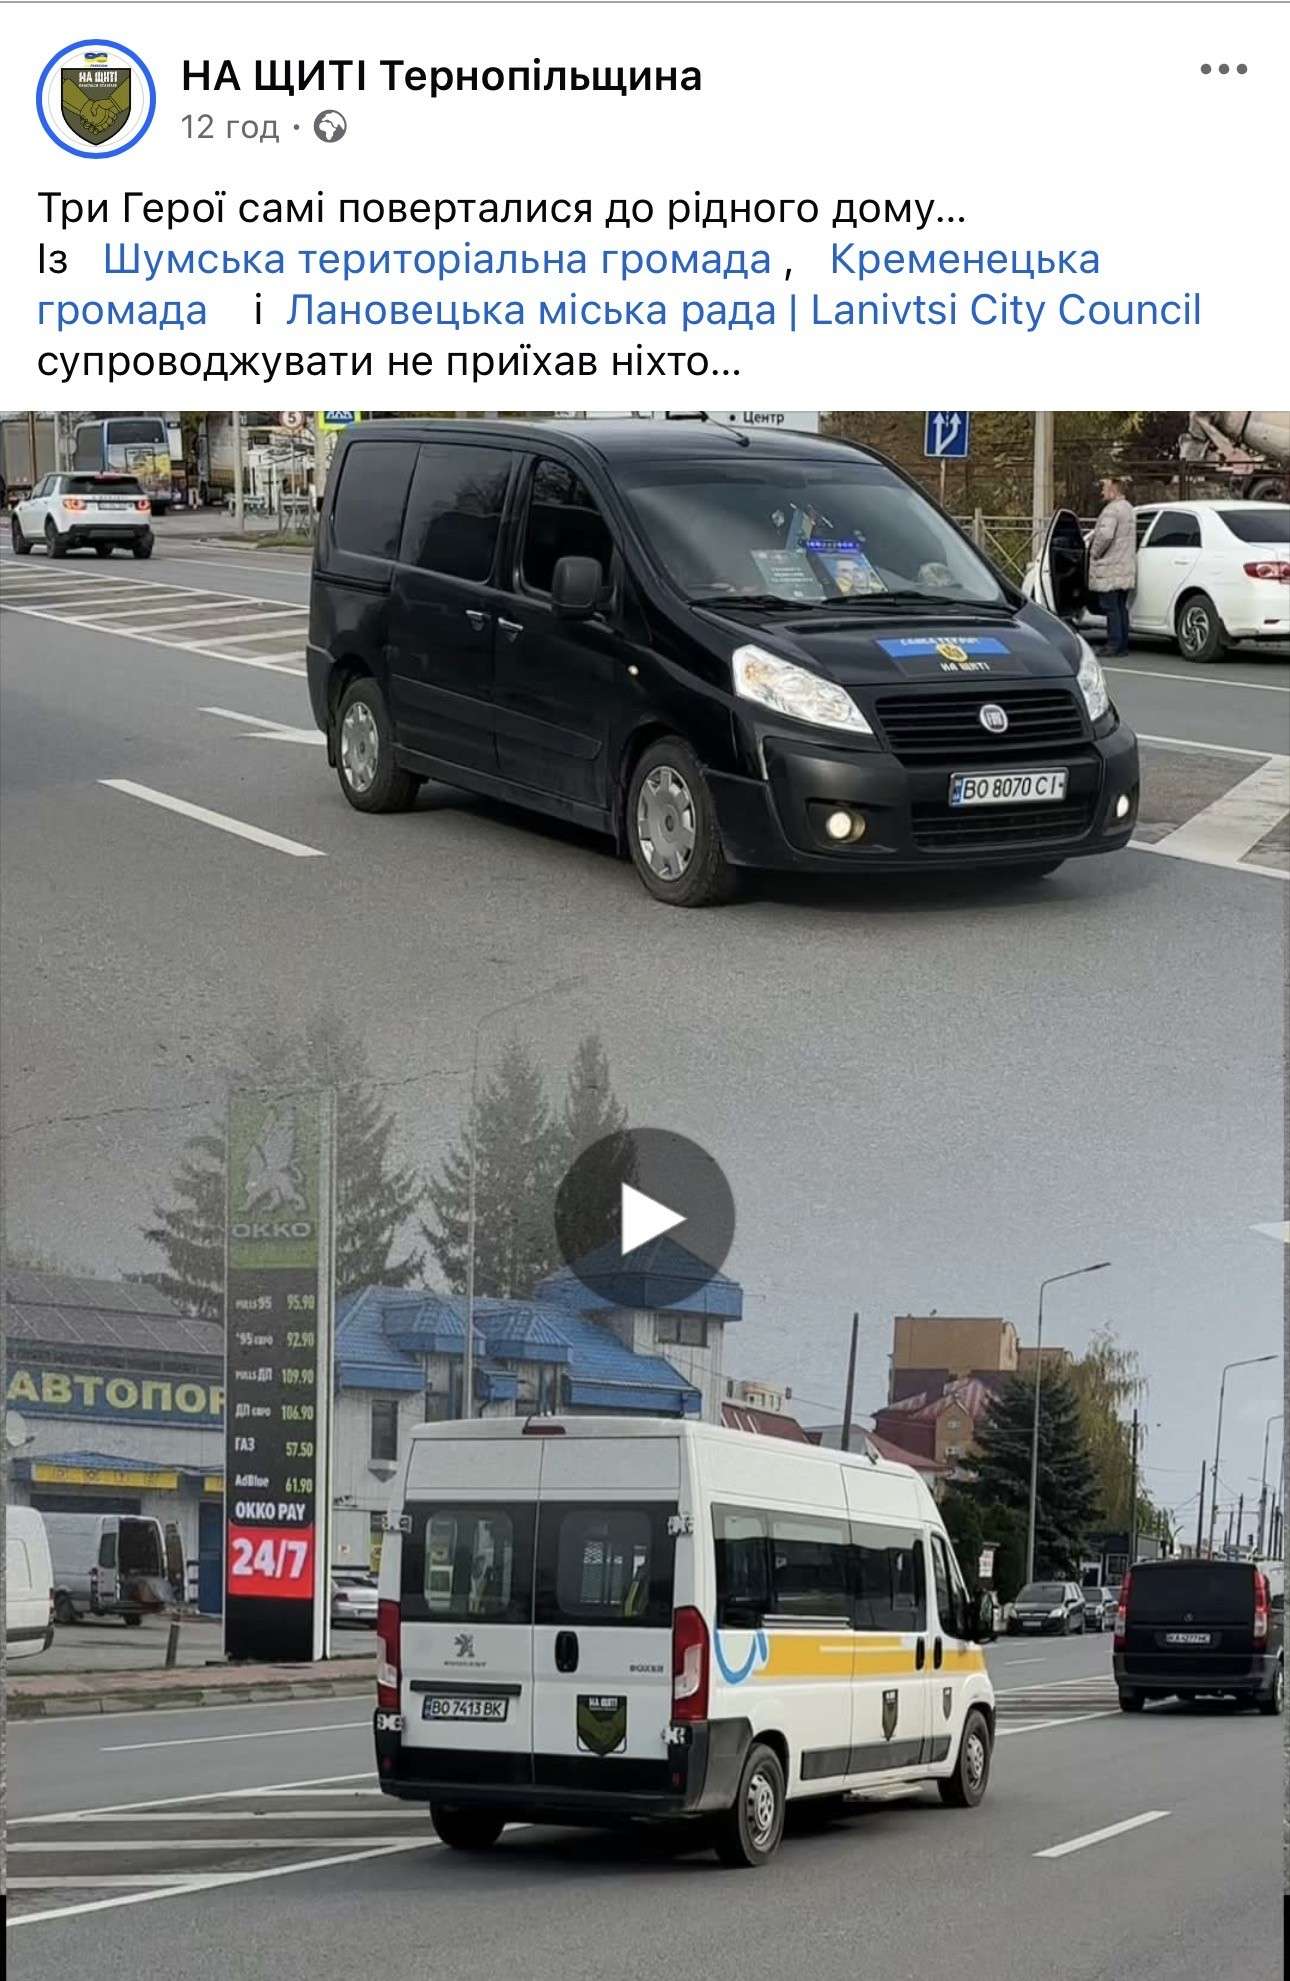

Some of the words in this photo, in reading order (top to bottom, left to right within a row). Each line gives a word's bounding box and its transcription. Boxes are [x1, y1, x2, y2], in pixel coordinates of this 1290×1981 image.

[288, 411, 297, 424] 5
[743, 411, 785, 425] Центр
[963, 780, 989, 800] BO
[992, 777, 1032, 798] 8070
[232, 1222, 311, 1238] OKKO
[282, 1368, 314, 1384] 109.90
[282, 1405, 314, 1420] 106.90
[235, 1437, 255, 1451] ГАЗ
[285, 1442, 313, 1457] 57.50
[285, 1477, 313, 1493] 61.90
[235, 1502, 275, 1519] OKKO
[278, 1503, 306, 1521] PAY
[231, 1537, 308, 1578] 24/7
[432, 1701, 450, 1714] BO
[452, 1701, 482, 1715] 7413
